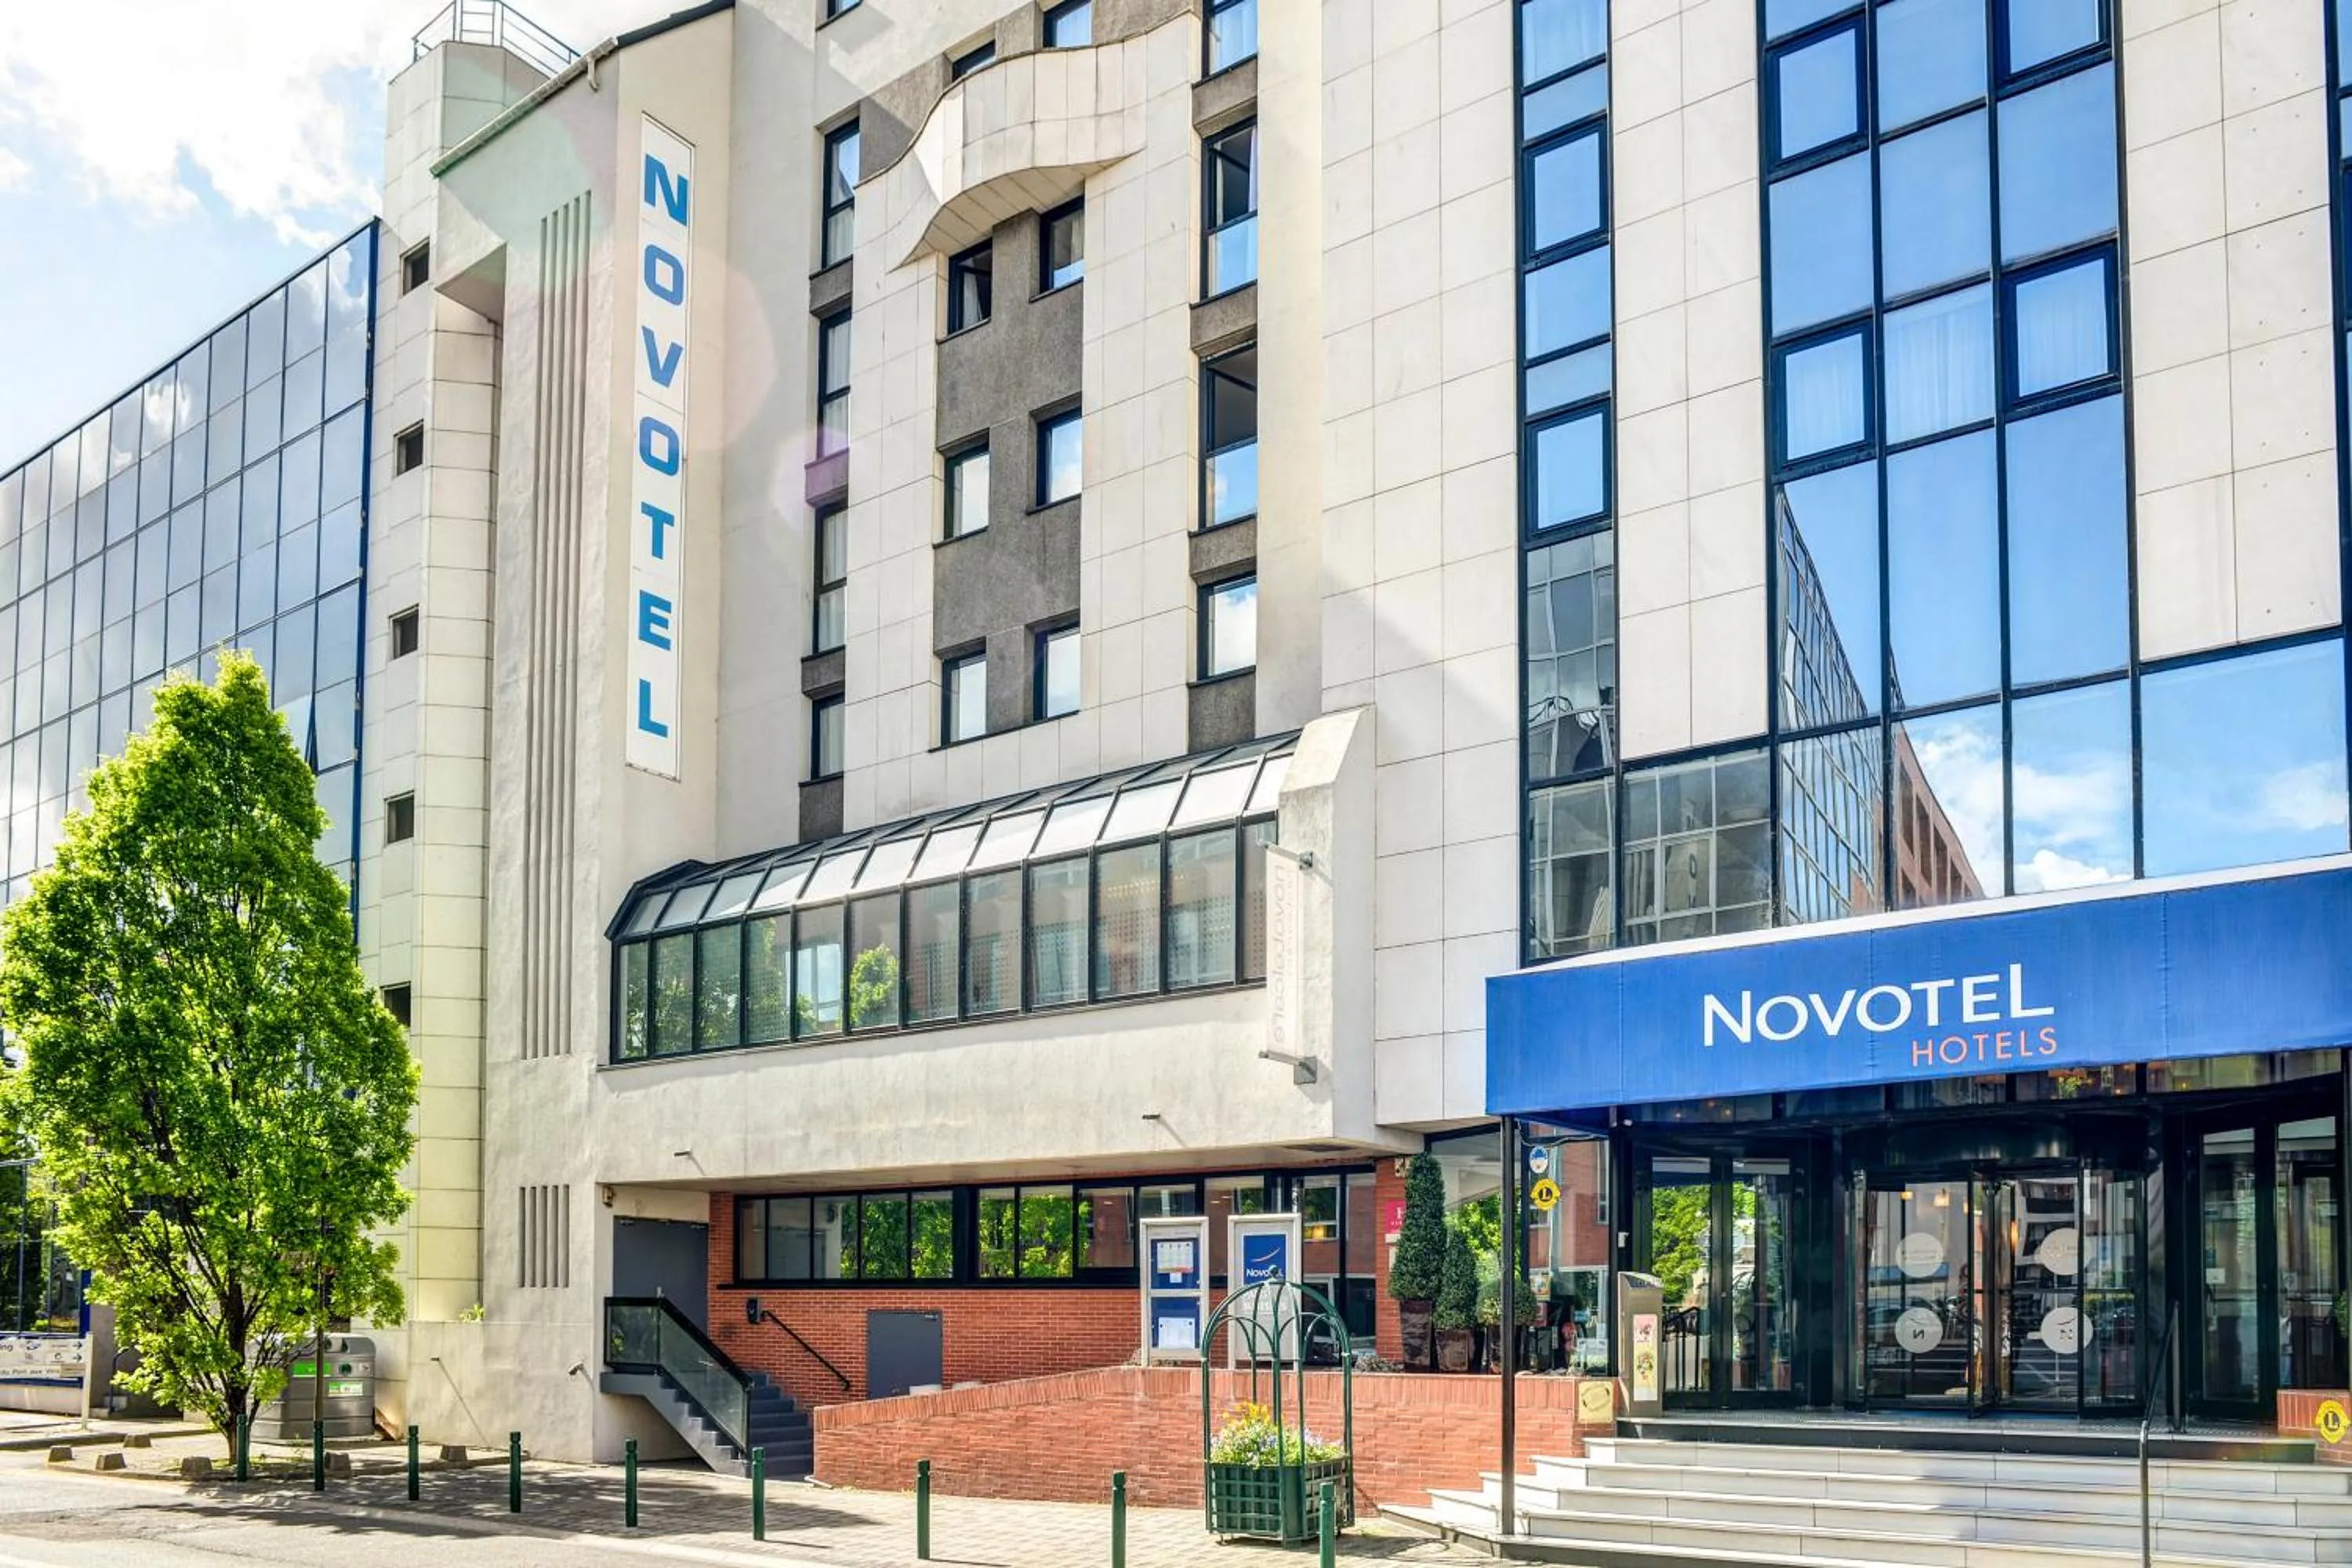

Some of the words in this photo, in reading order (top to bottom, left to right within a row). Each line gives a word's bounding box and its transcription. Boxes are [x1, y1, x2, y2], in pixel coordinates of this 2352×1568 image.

[638, 152, 688, 738] NOVOTEL
[1704, 964, 2055, 1047] NOVOTEL
[1911, 1027, 2057, 1067] HOTELS
[1246, 1268, 1283, 1277] NOVOL
